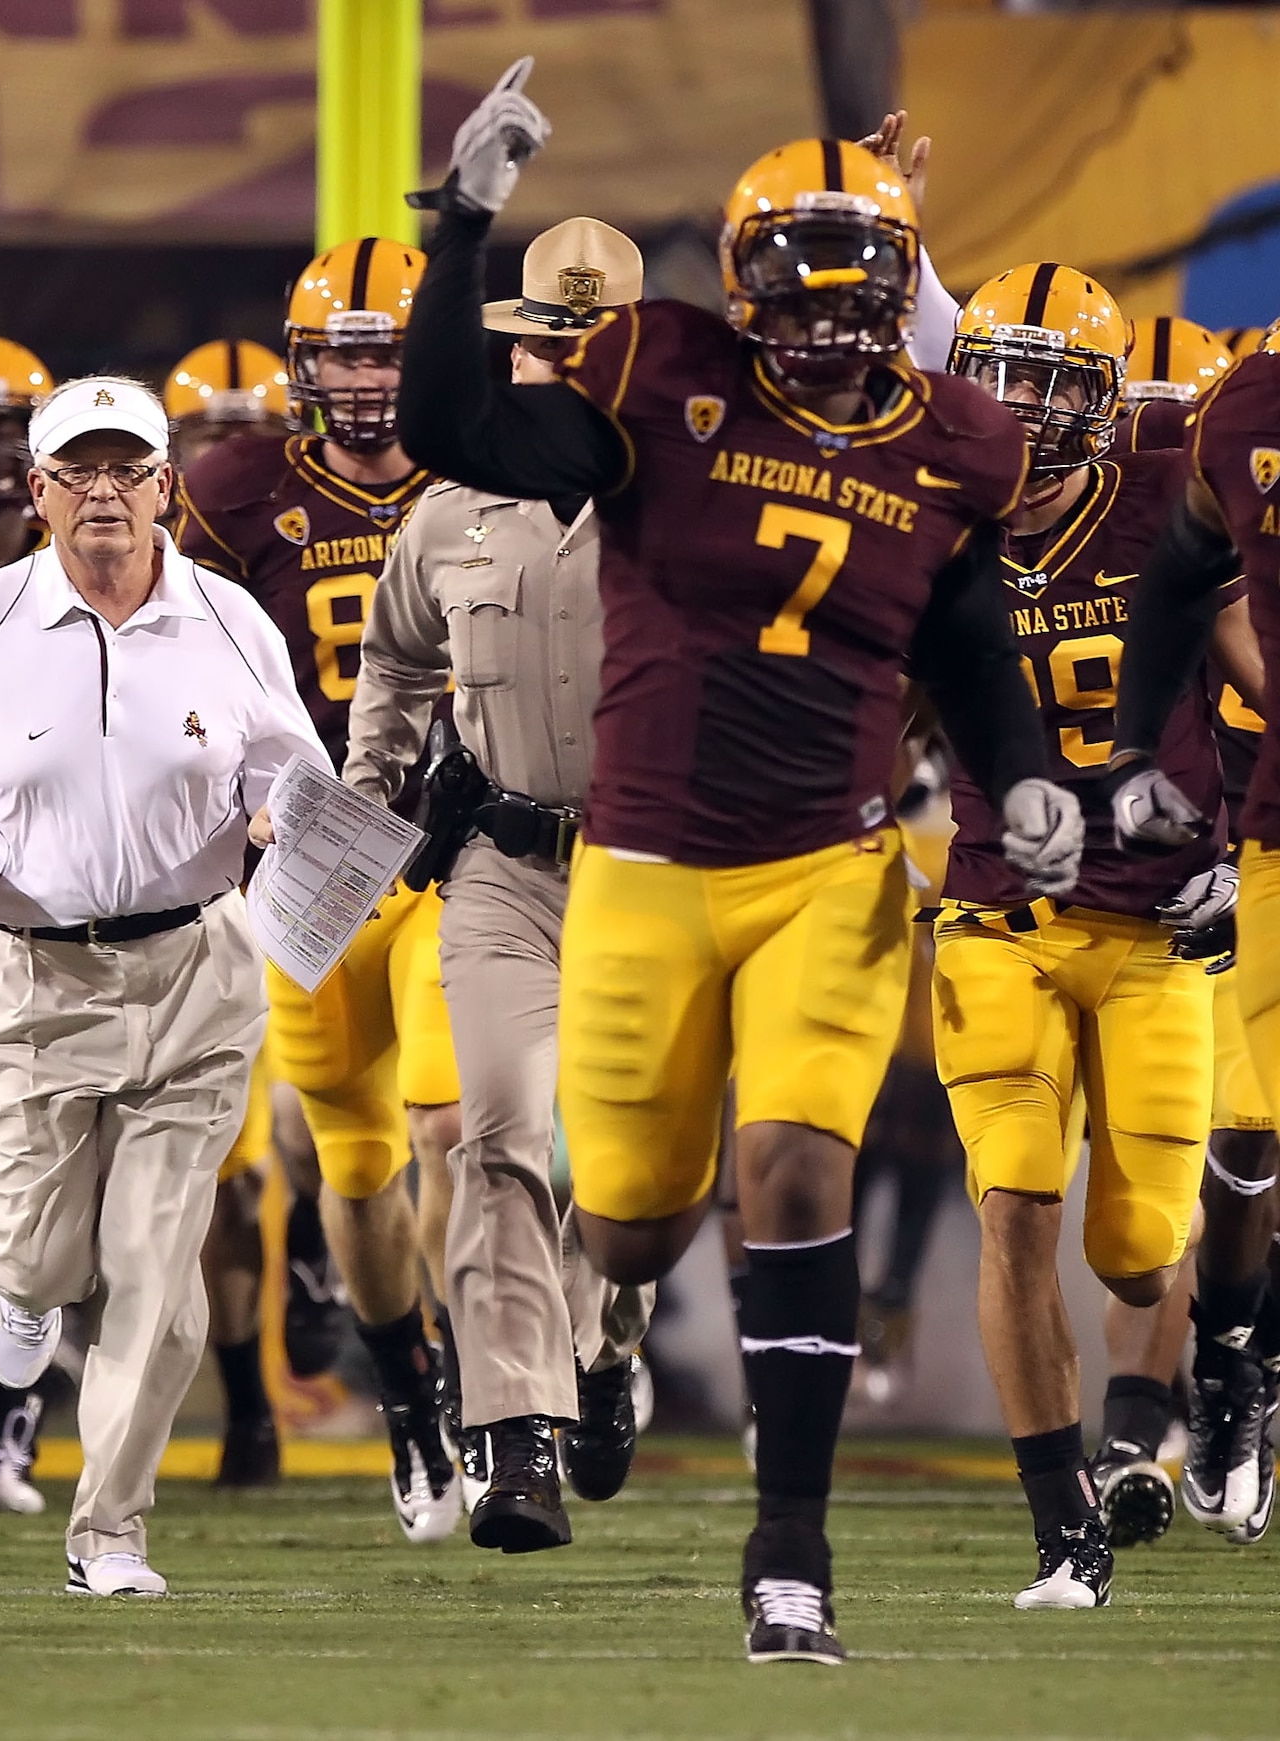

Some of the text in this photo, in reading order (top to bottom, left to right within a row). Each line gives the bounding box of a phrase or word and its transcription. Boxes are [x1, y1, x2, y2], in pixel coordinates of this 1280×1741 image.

[709, 450, 920, 533] ARIZONA STATE
[755, 501, 853, 657] 7
[1052, 596, 1129, 631] STATE
